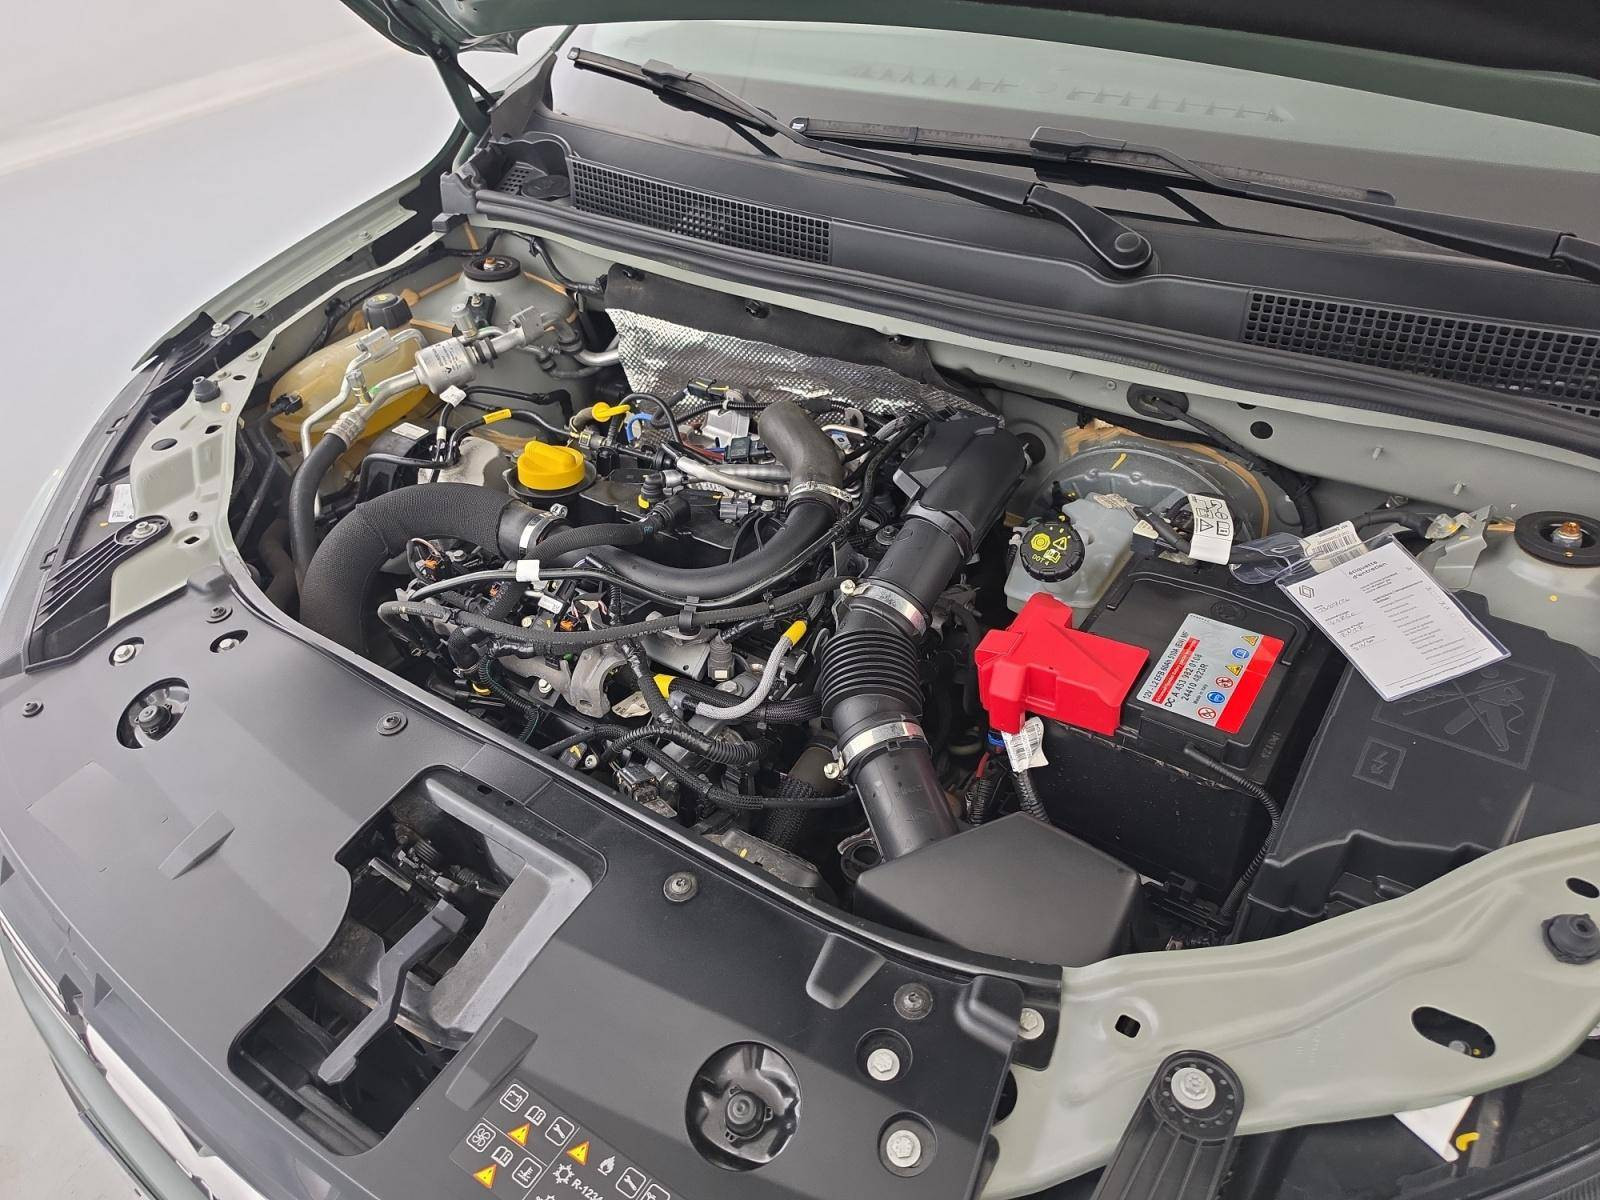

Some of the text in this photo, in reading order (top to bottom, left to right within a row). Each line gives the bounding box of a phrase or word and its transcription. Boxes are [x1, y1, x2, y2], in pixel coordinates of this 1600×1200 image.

[1032, 554, 1045, 563] DOT
[1142, 690, 1153, 699] 12V
[1154, 670, 1165, 681] EFB
[1164, 697, 1176, 707] DC
[1174, 679, 1186, 691] 453
